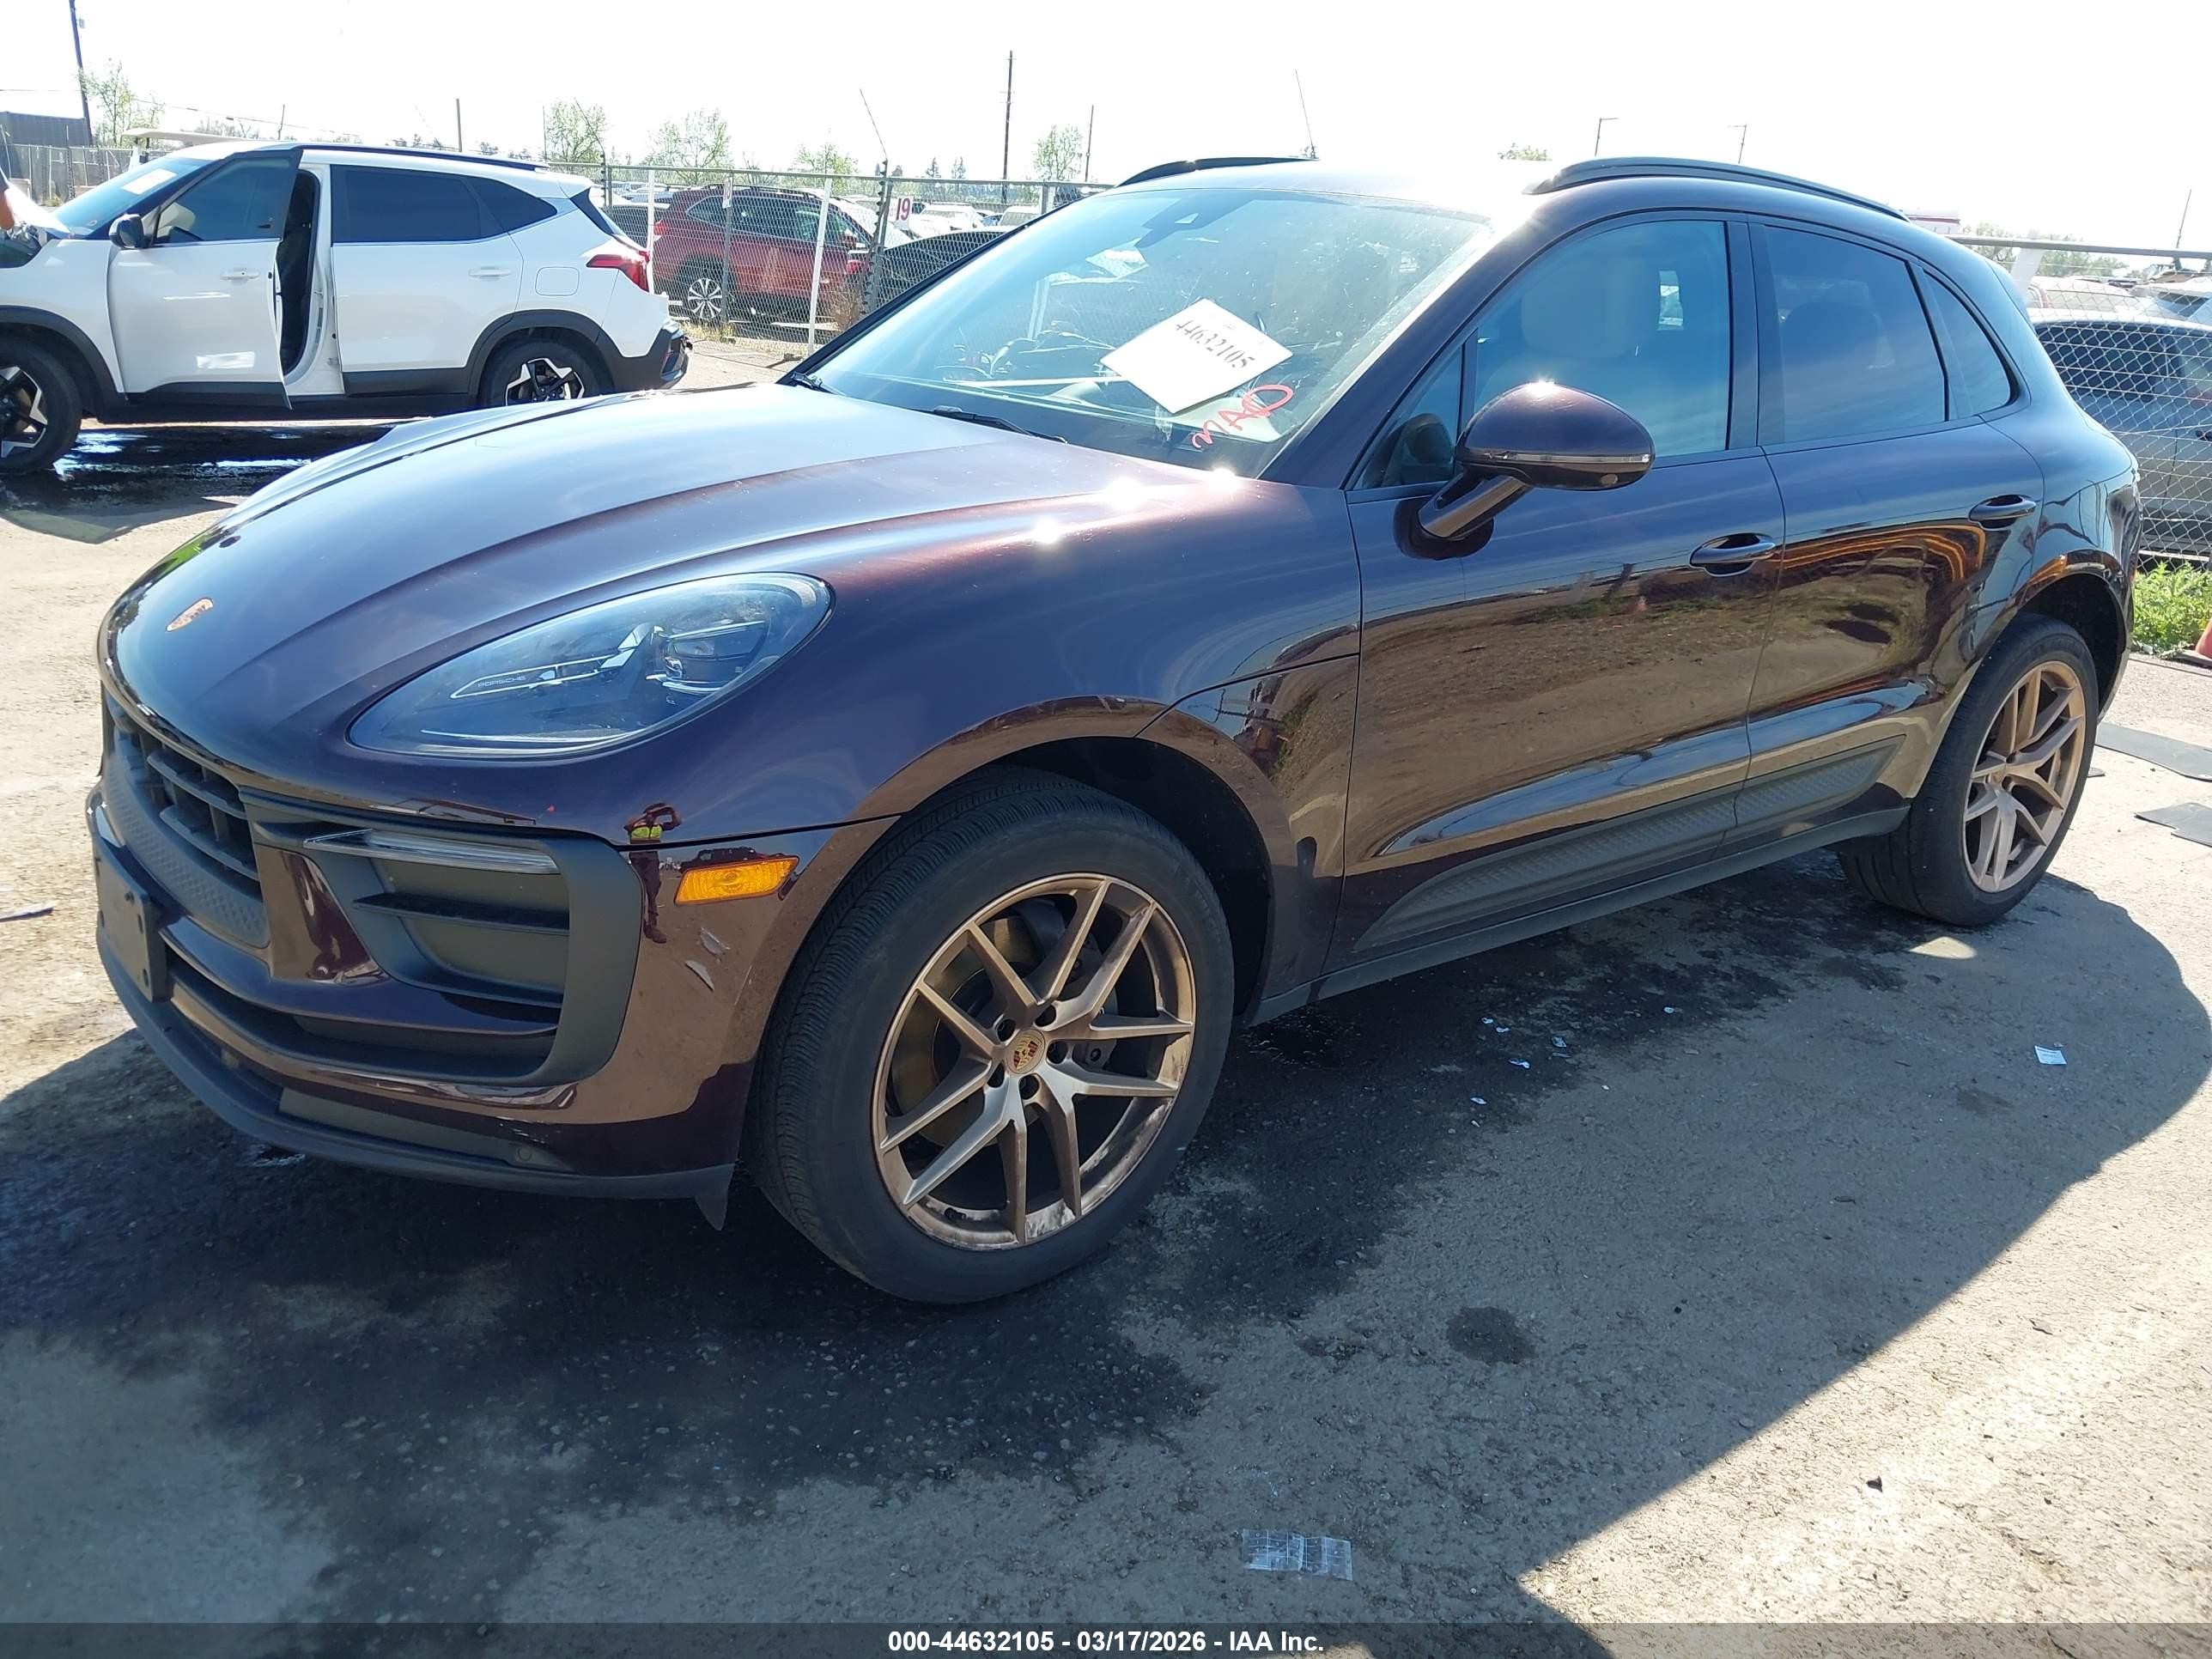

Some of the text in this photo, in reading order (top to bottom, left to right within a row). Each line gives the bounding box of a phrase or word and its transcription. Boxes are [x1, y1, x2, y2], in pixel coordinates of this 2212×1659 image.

[896, 198, 911, 221] 19
[1176, 320, 1255, 368] 44632105
[477, 676, 526, 687] PORSCHE
